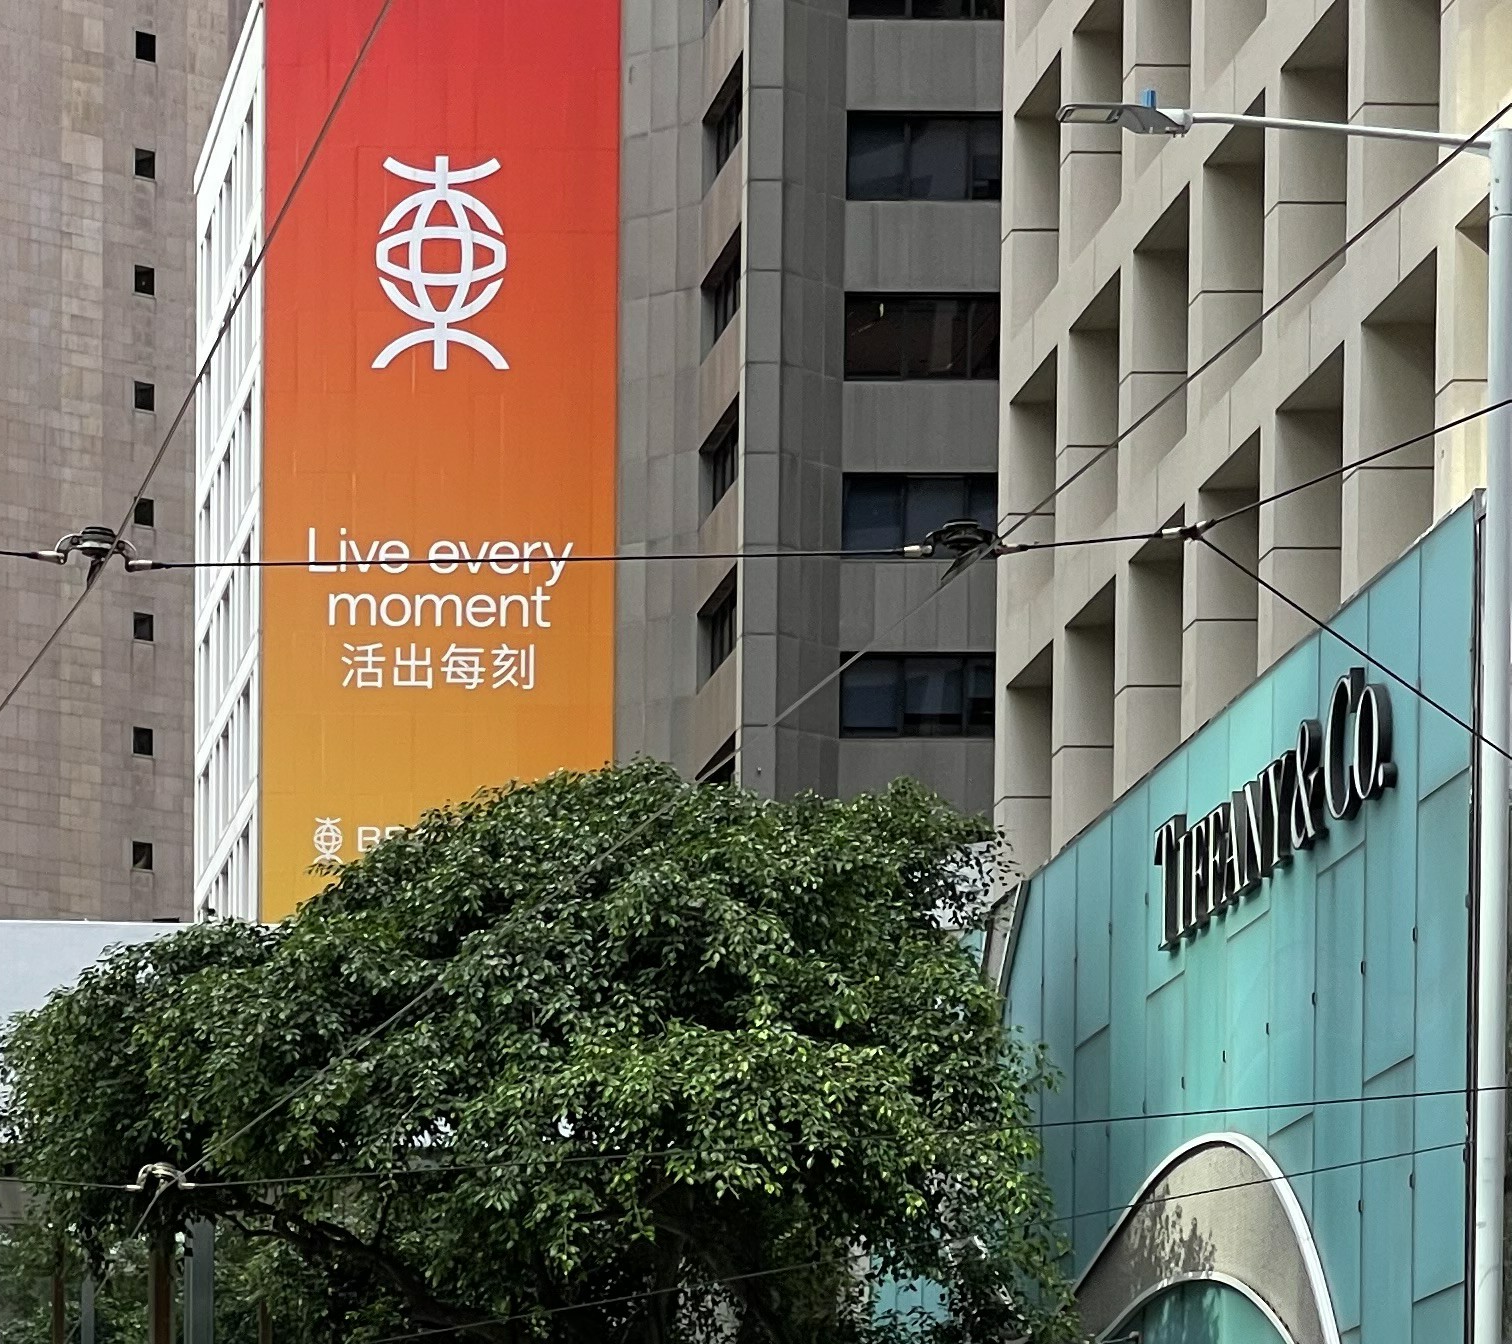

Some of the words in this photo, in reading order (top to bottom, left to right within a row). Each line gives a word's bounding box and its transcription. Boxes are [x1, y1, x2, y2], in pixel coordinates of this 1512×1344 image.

[308, 527, 410, 574] Live
[428, 539, 574, 587] every
[328, 586, 551, 627] moment
[341, 642, 535, 690] 活出每刻
[1155, 749, 1298, 951] TIFFANY
[1290, 718, 1329, 850] &
[1324, 666, 1398, 820] Co.
